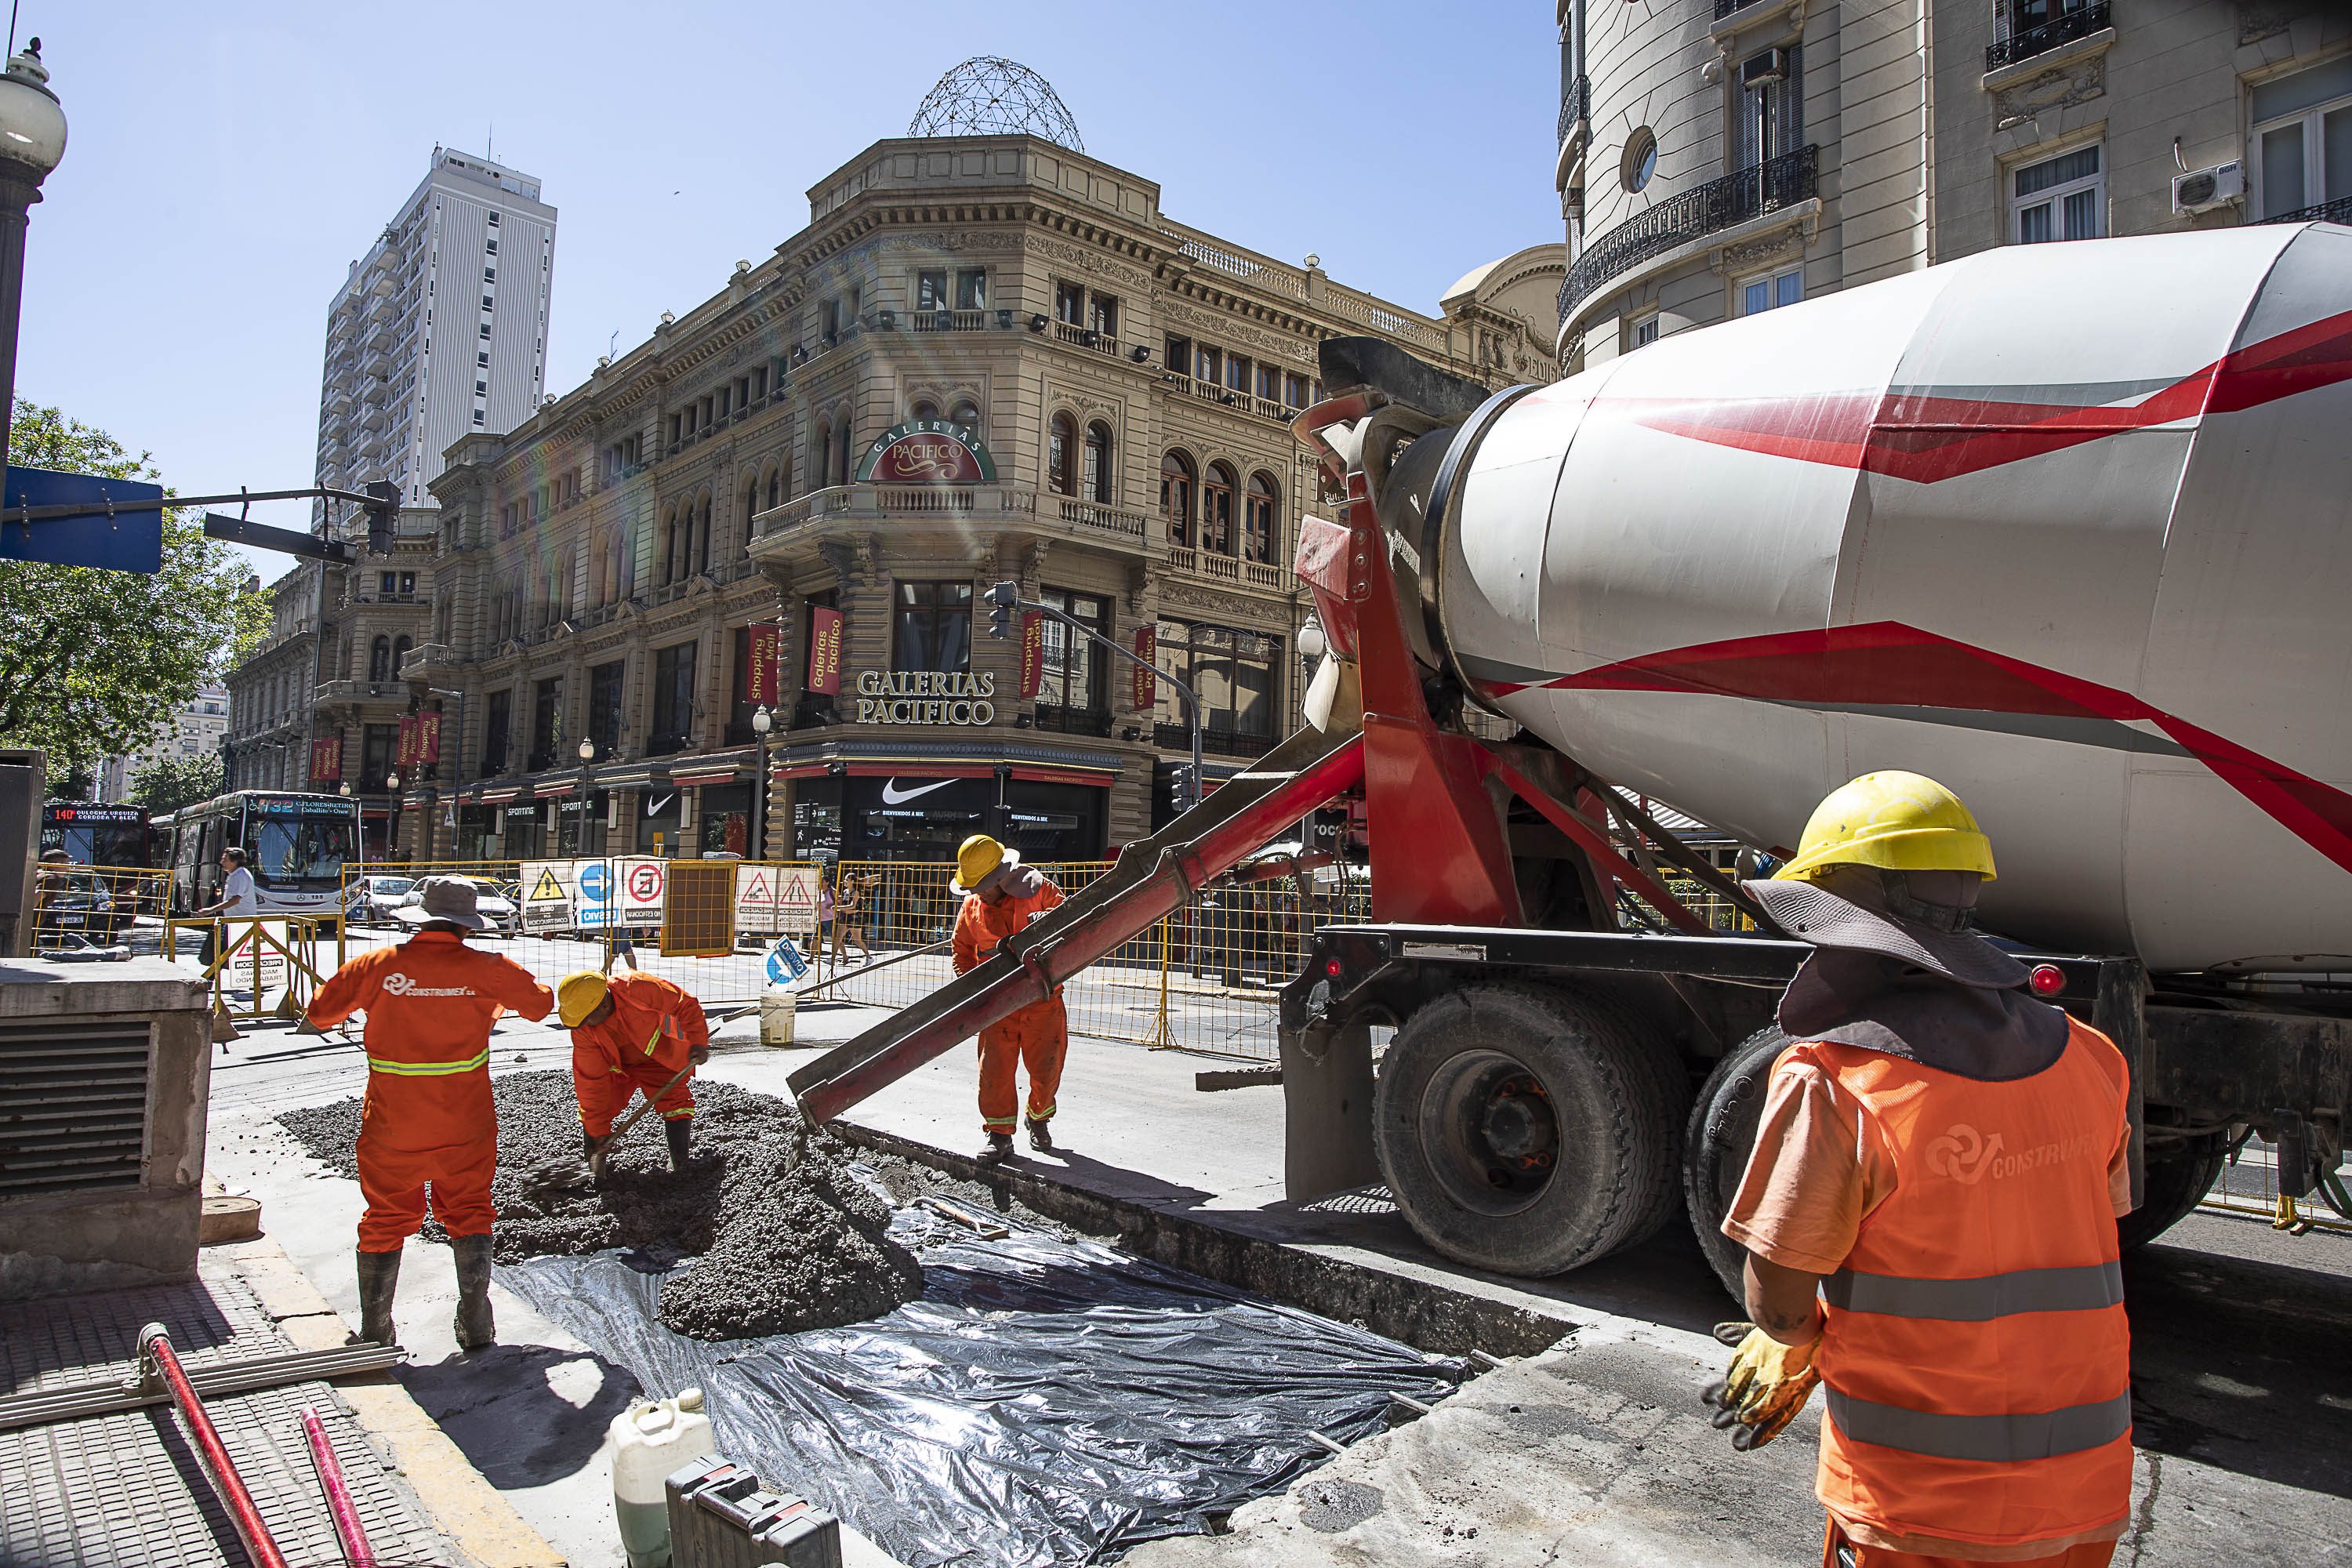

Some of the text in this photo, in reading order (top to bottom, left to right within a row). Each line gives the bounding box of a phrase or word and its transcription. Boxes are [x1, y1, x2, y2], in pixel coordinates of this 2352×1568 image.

[2219, 164, 2237, 174] BGH
[892, 445, 964, 459] PACIFICO
[765, 633, 775, 660] Mall
[814, 630, 827, 688] Galerías
[827, 619, 840, 673] Pacífico
[752, 638, 765, 699] Shopping
[1023, 627, 1034, 693] Shopping
[856, 670, 995, 697] GALERIAS
[1136, 649, 1145, 706] Galerís
[856, 699, 995, 726] PACIFICO
[419, 720, 431, 759] Shopping
[258, 799, 293, 812] 132
[507, 807, 535, 816] SPORTING
[561, 800, 593, 811] SPORTG
[782, 942, 804, 972] DESVIO
